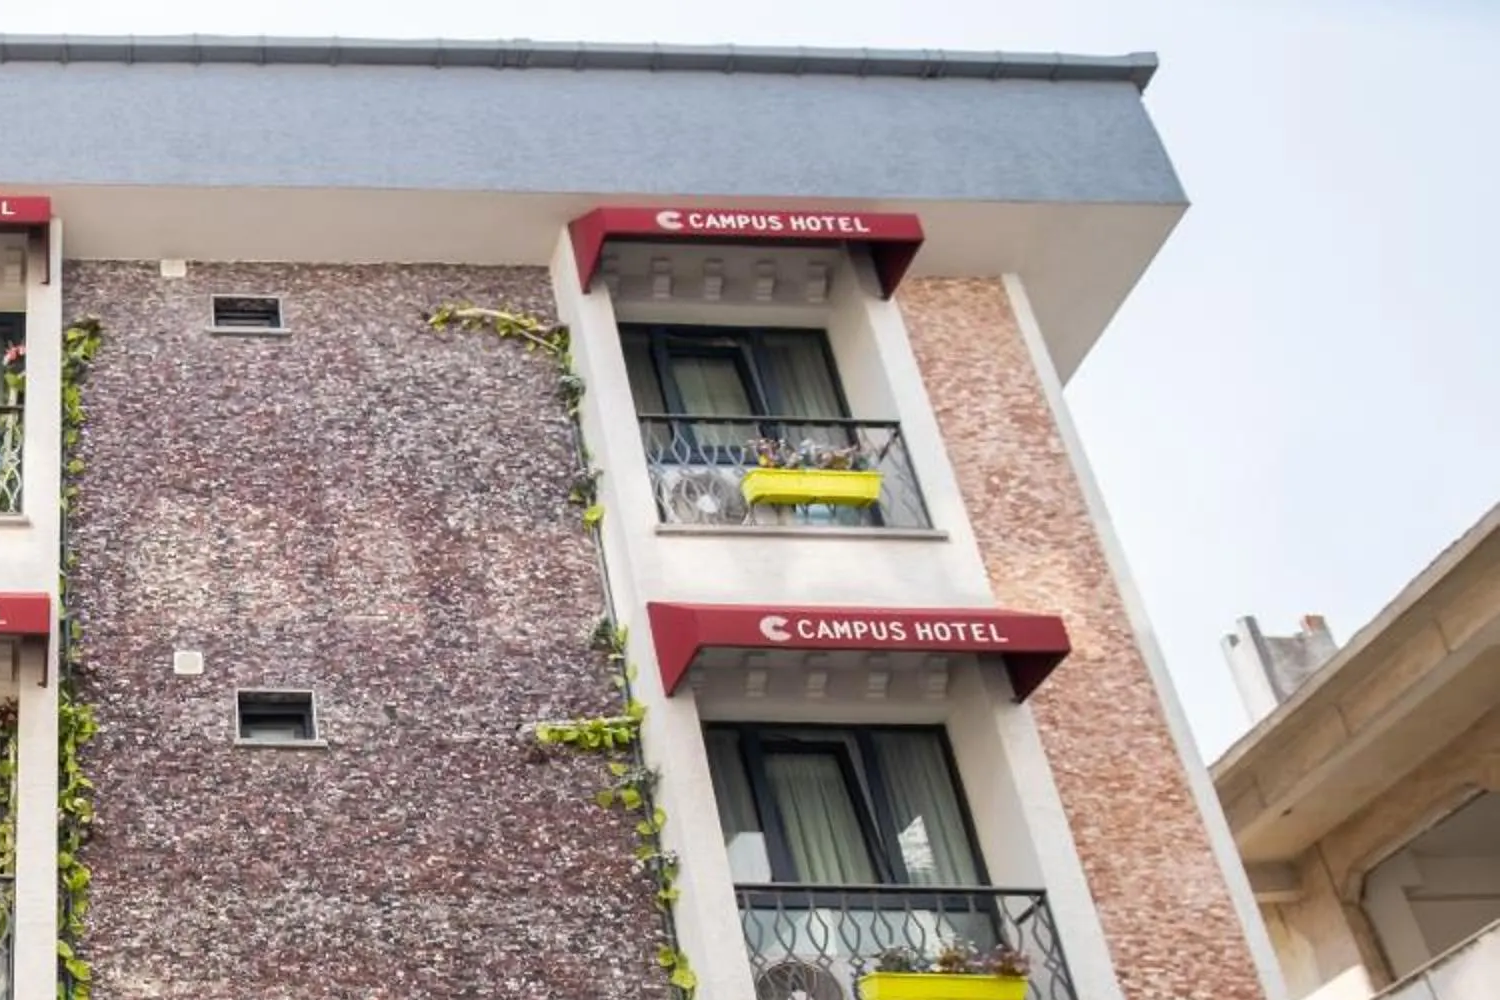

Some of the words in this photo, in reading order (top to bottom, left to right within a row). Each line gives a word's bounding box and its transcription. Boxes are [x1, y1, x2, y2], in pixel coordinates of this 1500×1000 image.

[689, 213, 784, 230] CAMPUS
[790, 215, 870, 232] HOTEL
[797, 619, 907, 641] CAMPUS
[914, 621, 1009, 643] HOTEL
